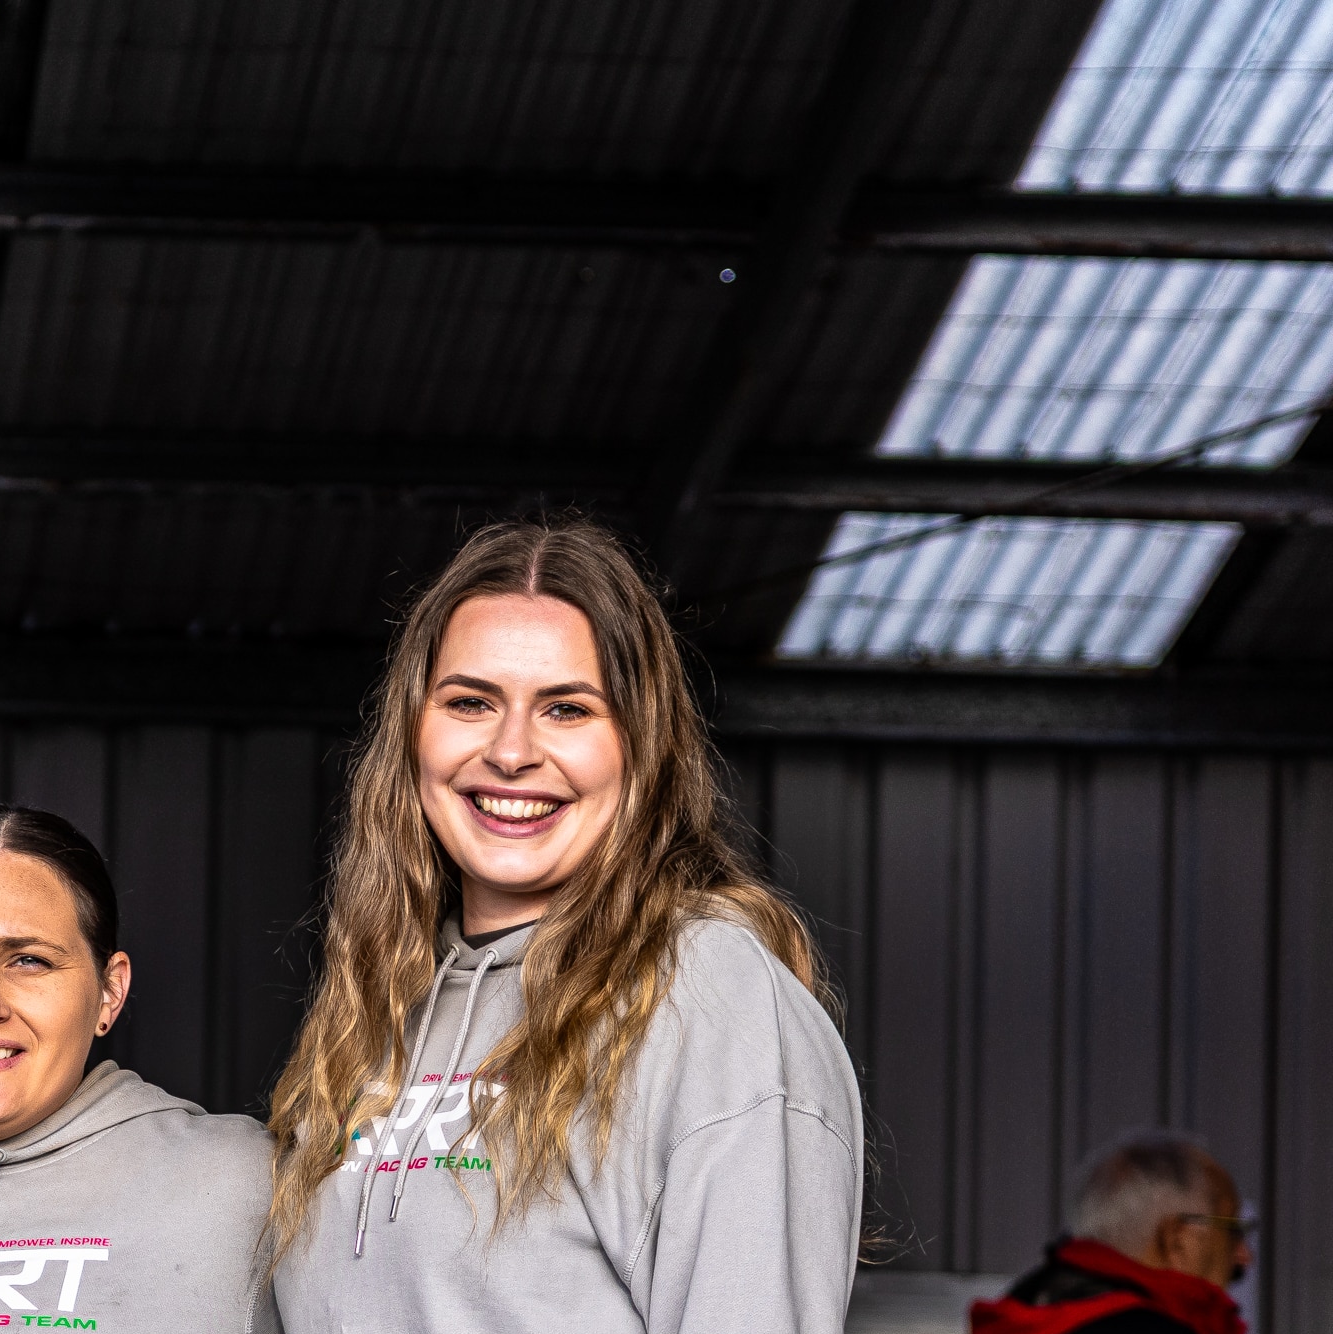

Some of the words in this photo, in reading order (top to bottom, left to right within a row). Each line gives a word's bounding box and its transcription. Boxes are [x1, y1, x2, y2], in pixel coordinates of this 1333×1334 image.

[365, 1157, 428, 1172] ACNG
[434, 1156, 492, 1171] TEAM
[60, 1237, 112, 1247] INSPIRE.
[21, 1314, 96, 1330] TEAM
